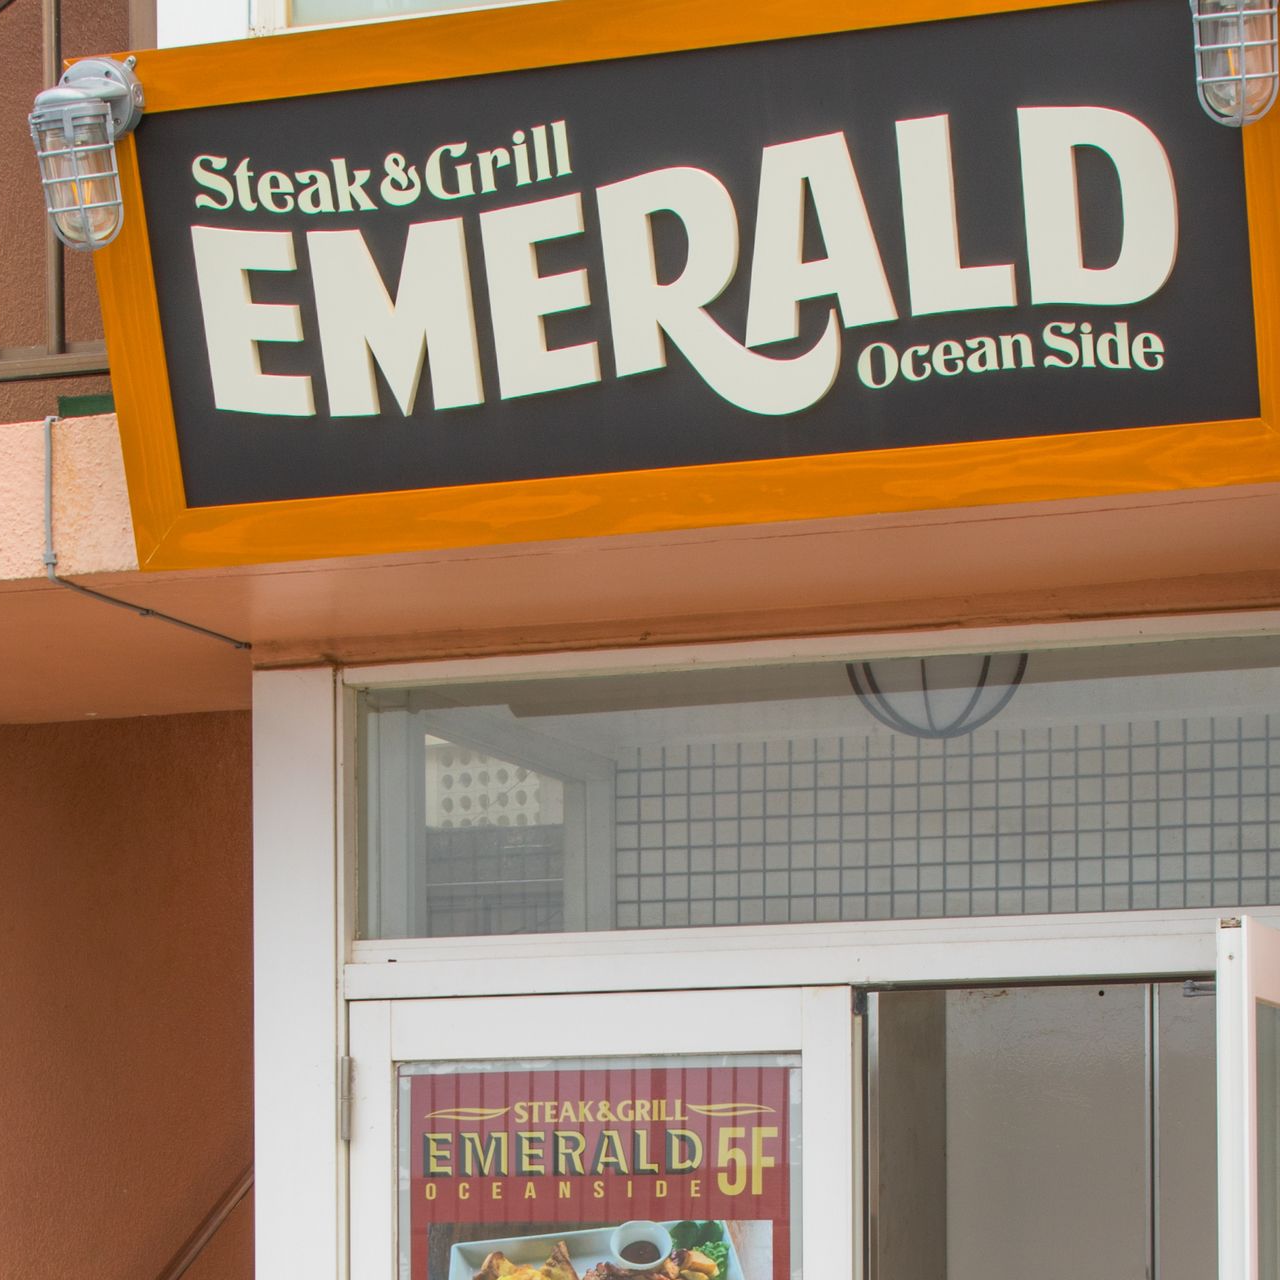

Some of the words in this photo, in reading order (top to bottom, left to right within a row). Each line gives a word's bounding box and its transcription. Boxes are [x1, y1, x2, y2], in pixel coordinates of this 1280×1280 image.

[190, 105, 1179, 417] EMERALD
[857, 329, 1035, 390] Ocean
[1043, 321, 1165, 371] Side
[514, 1099, 688, 1123] STEAK&GRILL
[423, 1128, 703, 1177] EMERALD
[717, 1127, 778, 1196] 5F
[425, 1180, 701, 1200] OCEANSIDE
